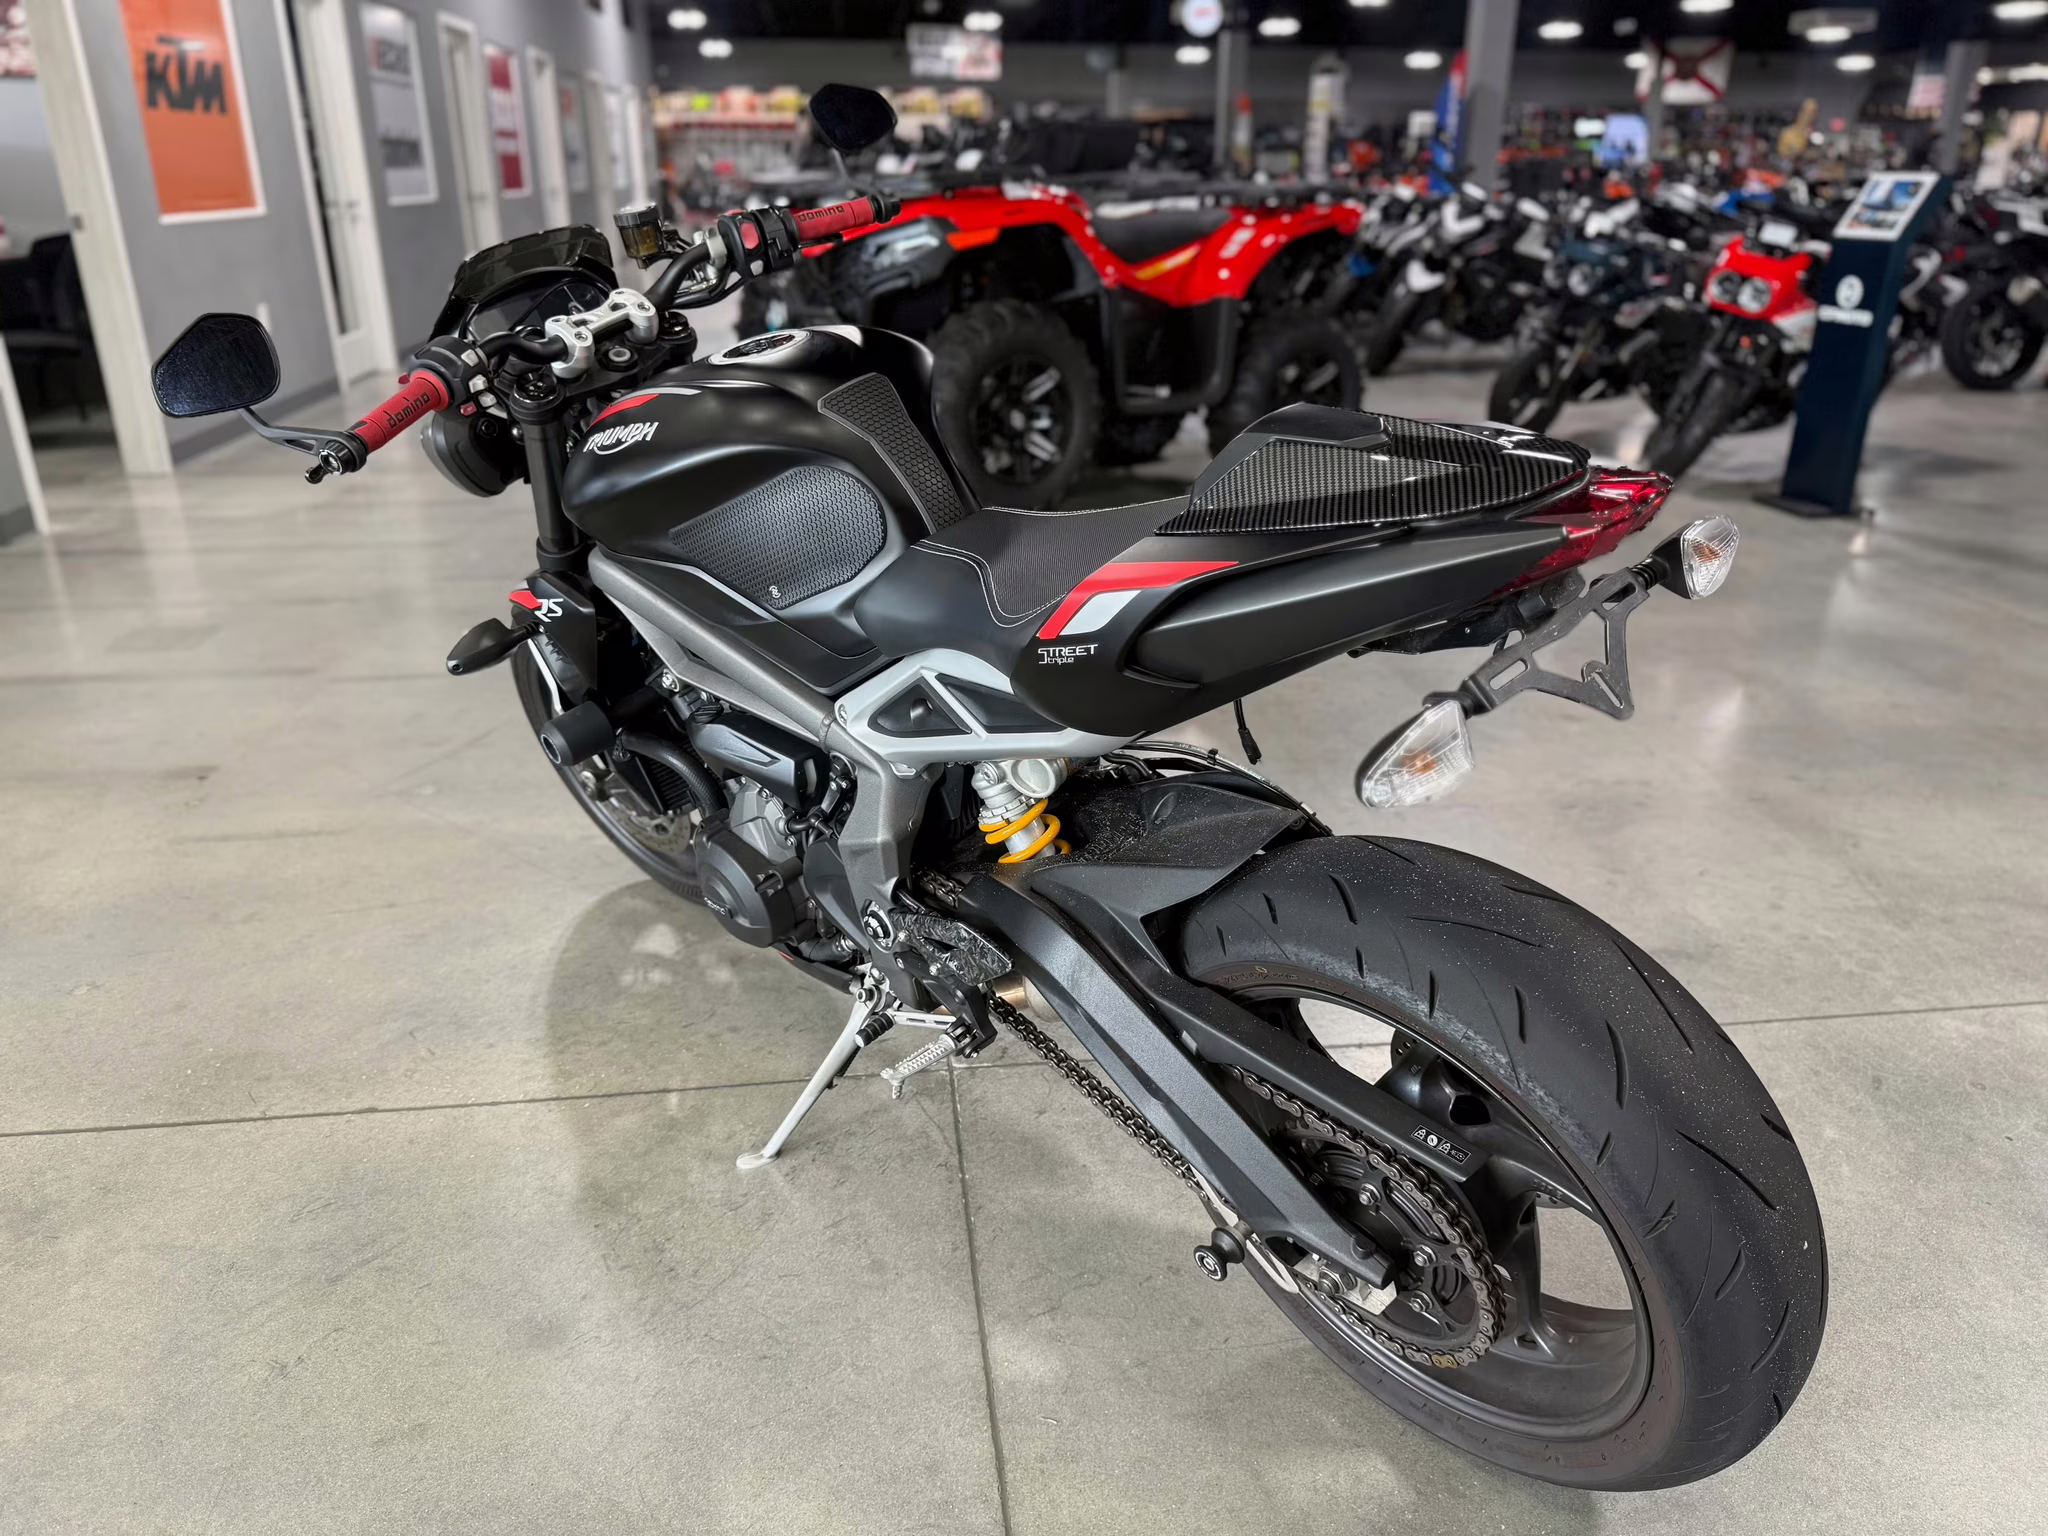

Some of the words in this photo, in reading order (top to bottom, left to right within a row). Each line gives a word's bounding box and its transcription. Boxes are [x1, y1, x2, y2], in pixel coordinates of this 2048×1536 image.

[145, 35, 227, 116] KTM
[797, 205, 845, 223] domino
[383, 392, 431, 429] domino
[582, 421, 659, 455] TRIUMPH
[534, 598, 564, 623] RS
[1037, 643, 1099, 665] STREET
[1047, 655, 1075, 666] triple
